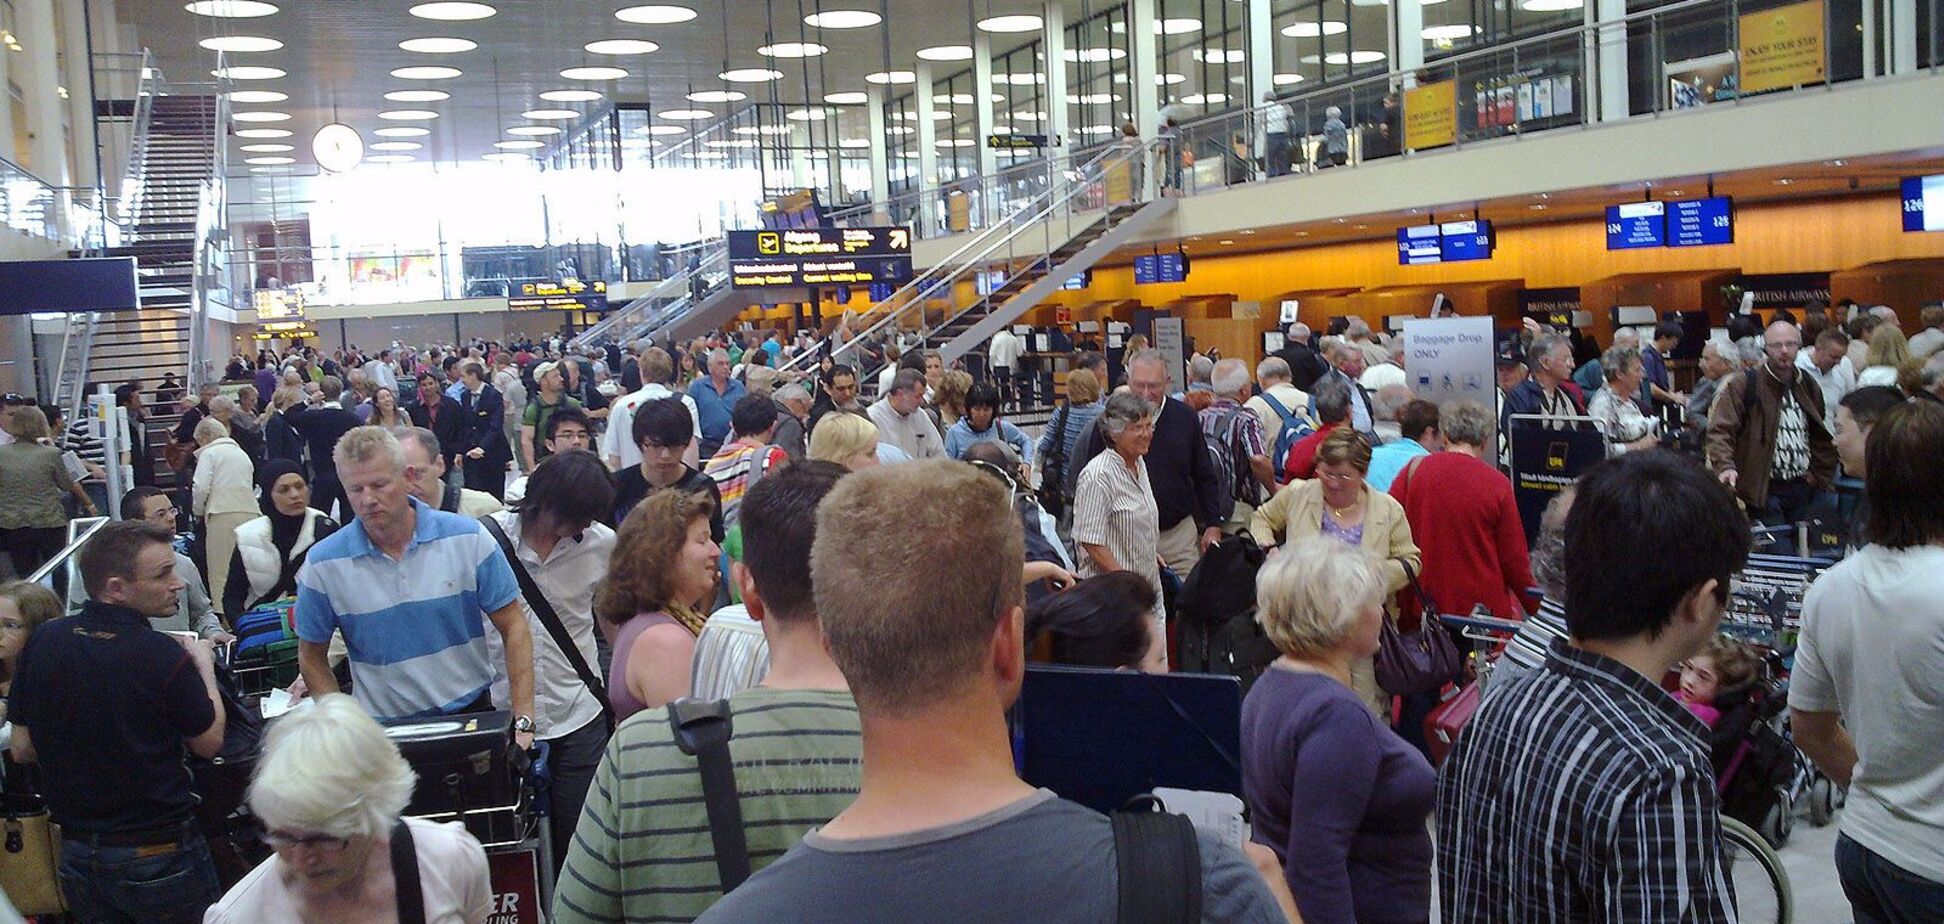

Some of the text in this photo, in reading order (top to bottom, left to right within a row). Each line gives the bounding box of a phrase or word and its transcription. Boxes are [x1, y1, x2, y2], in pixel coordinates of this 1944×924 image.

[1772, 40, 1794, 51] YOUR
[734, 274, 793, 286] Security Control
[1754, 288, 1831, 302] RITISH AIRWAYS
[1413, 332, 1482, 345] Baggage Drop
[1414, 348, 1440, 360] ONLY
